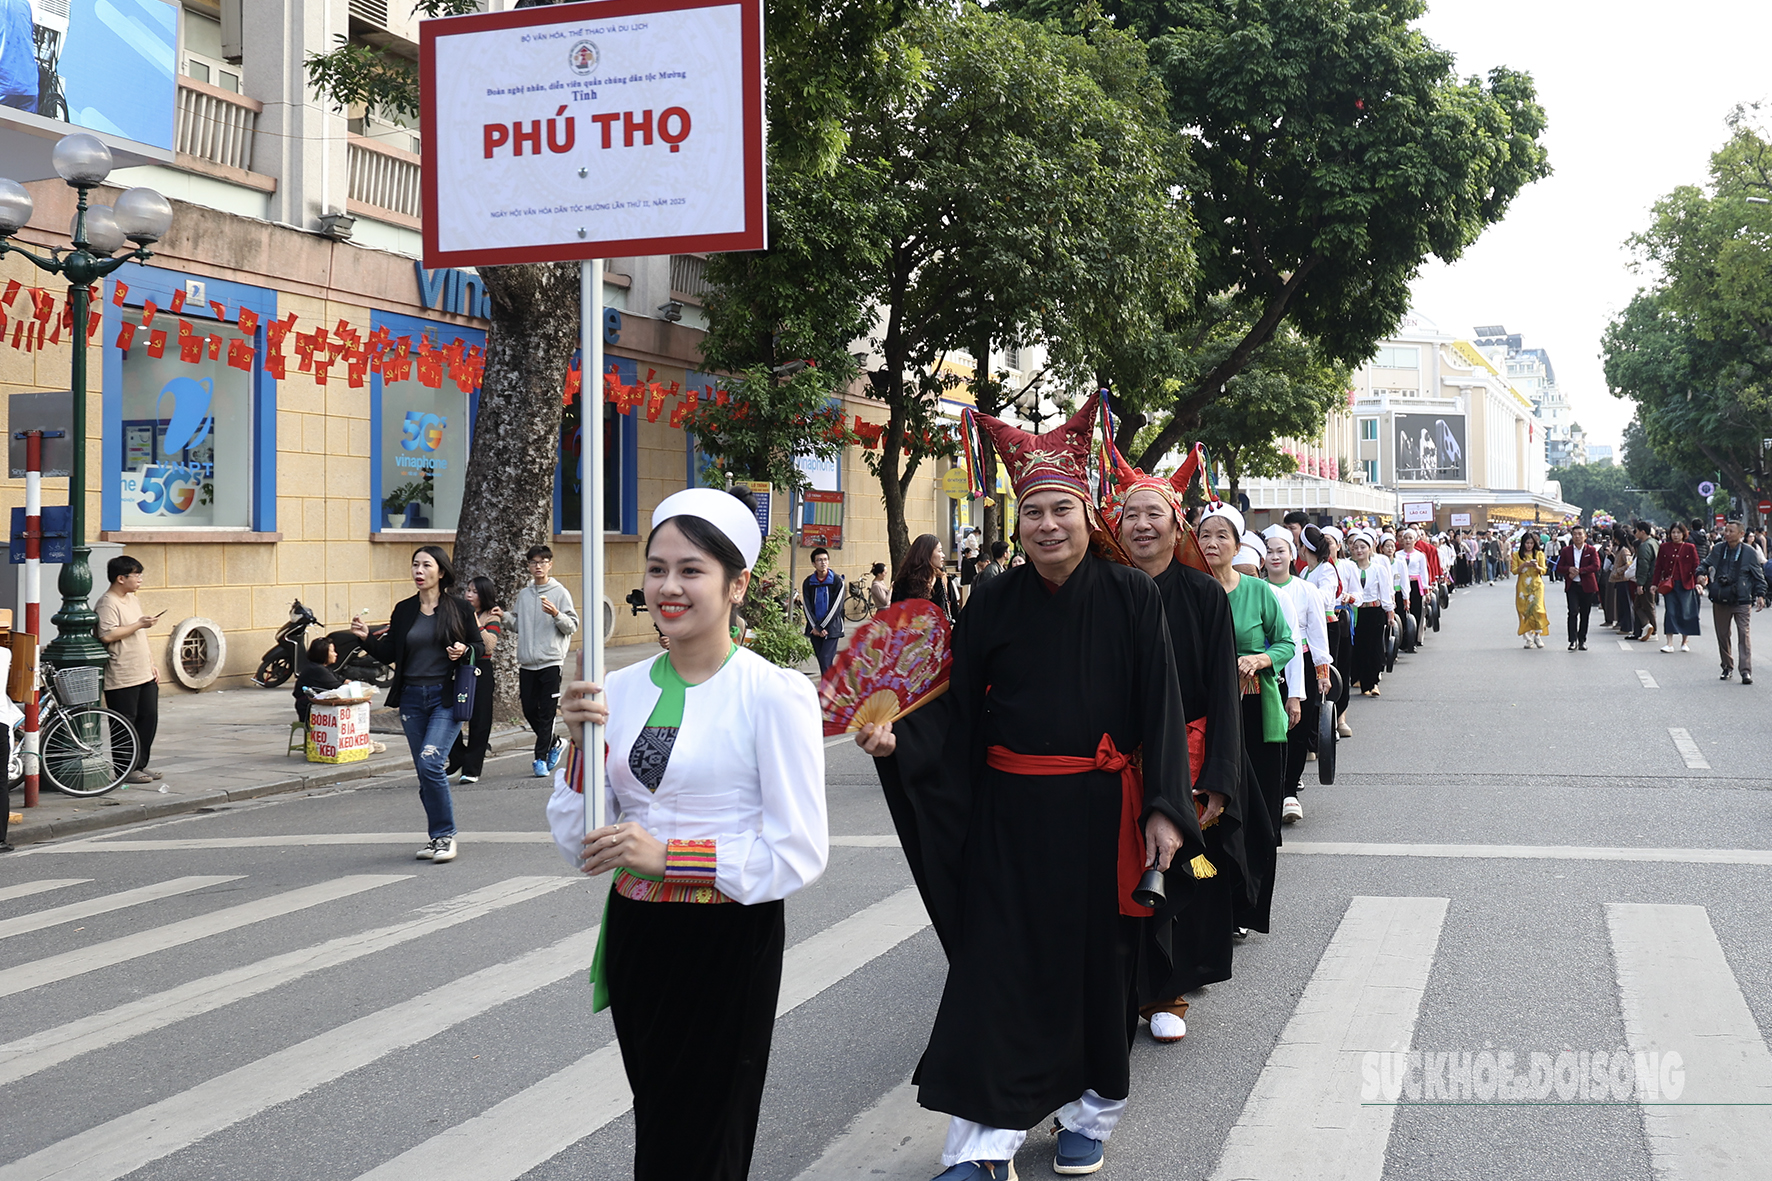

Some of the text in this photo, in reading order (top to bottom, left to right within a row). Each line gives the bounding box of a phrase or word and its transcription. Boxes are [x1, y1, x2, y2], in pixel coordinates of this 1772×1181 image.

[521, 34, 531, 42] BỘ
[533, 33, 547, 41] VĂN
[568, 28, 583, 37] THẾ
[585, 27, 604, 36] THAO
[606, 25, 616, 33] VÀ
[631, 23, 648, 31] LỊCH
[566, 80, 581, 88] viên
[604, 76, 627, 85] chúng
[629, 74, 643, 82] dân
[645, 72, 656, 82] tộc
[659, 70, 687, 79] Mường
[483, 104, 692, 160] PHÚ THỌ
[490, 210, 507, 218] NGÀY
[509, 208, 522, 217] HỘI
[523, 207, 537, 215] VĂN
[570, 204, 583, 213] TỘC
[653, 198, 668, 206] NĂM
[669, 197, 686, 206] 2025
[156, 460, 214, 476] VNPT
[395, 453, 448, 470] vinaphone
